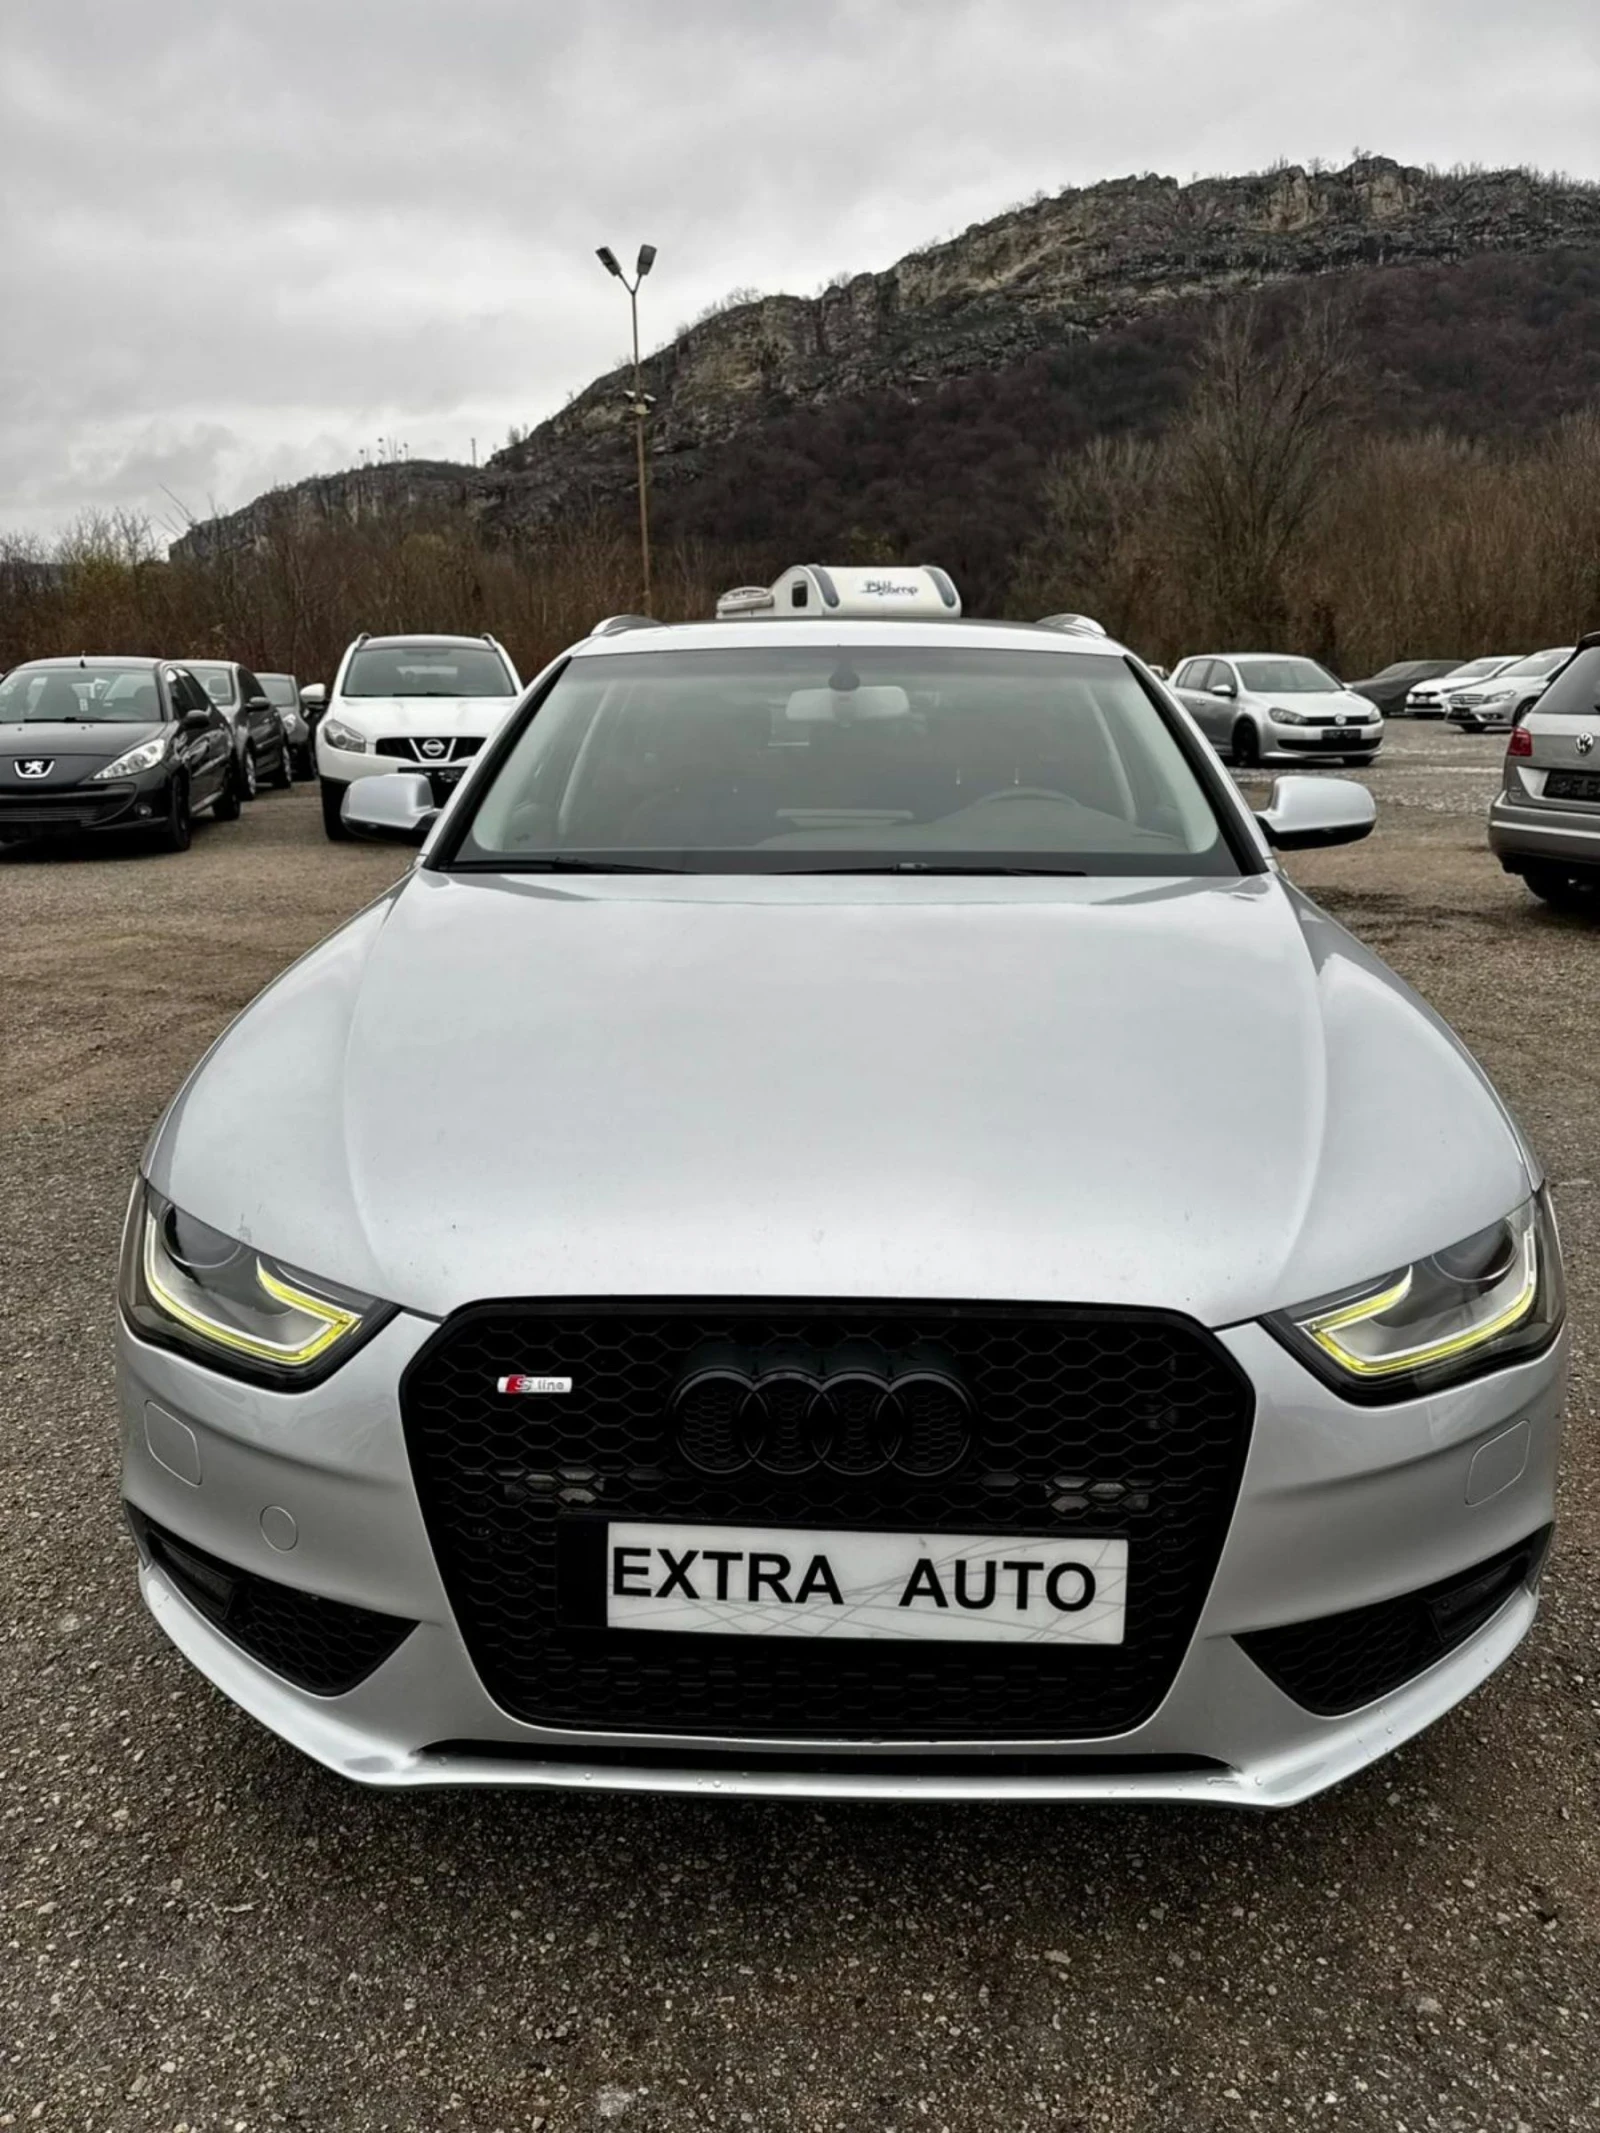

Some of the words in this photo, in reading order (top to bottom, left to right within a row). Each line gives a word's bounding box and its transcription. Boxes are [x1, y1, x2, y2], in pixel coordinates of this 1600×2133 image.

[538, 1379, 564, 1391] line
[613, 1546, 844, 1605] EXTRA
[898, 1557, 1097, 1612] AUTO
